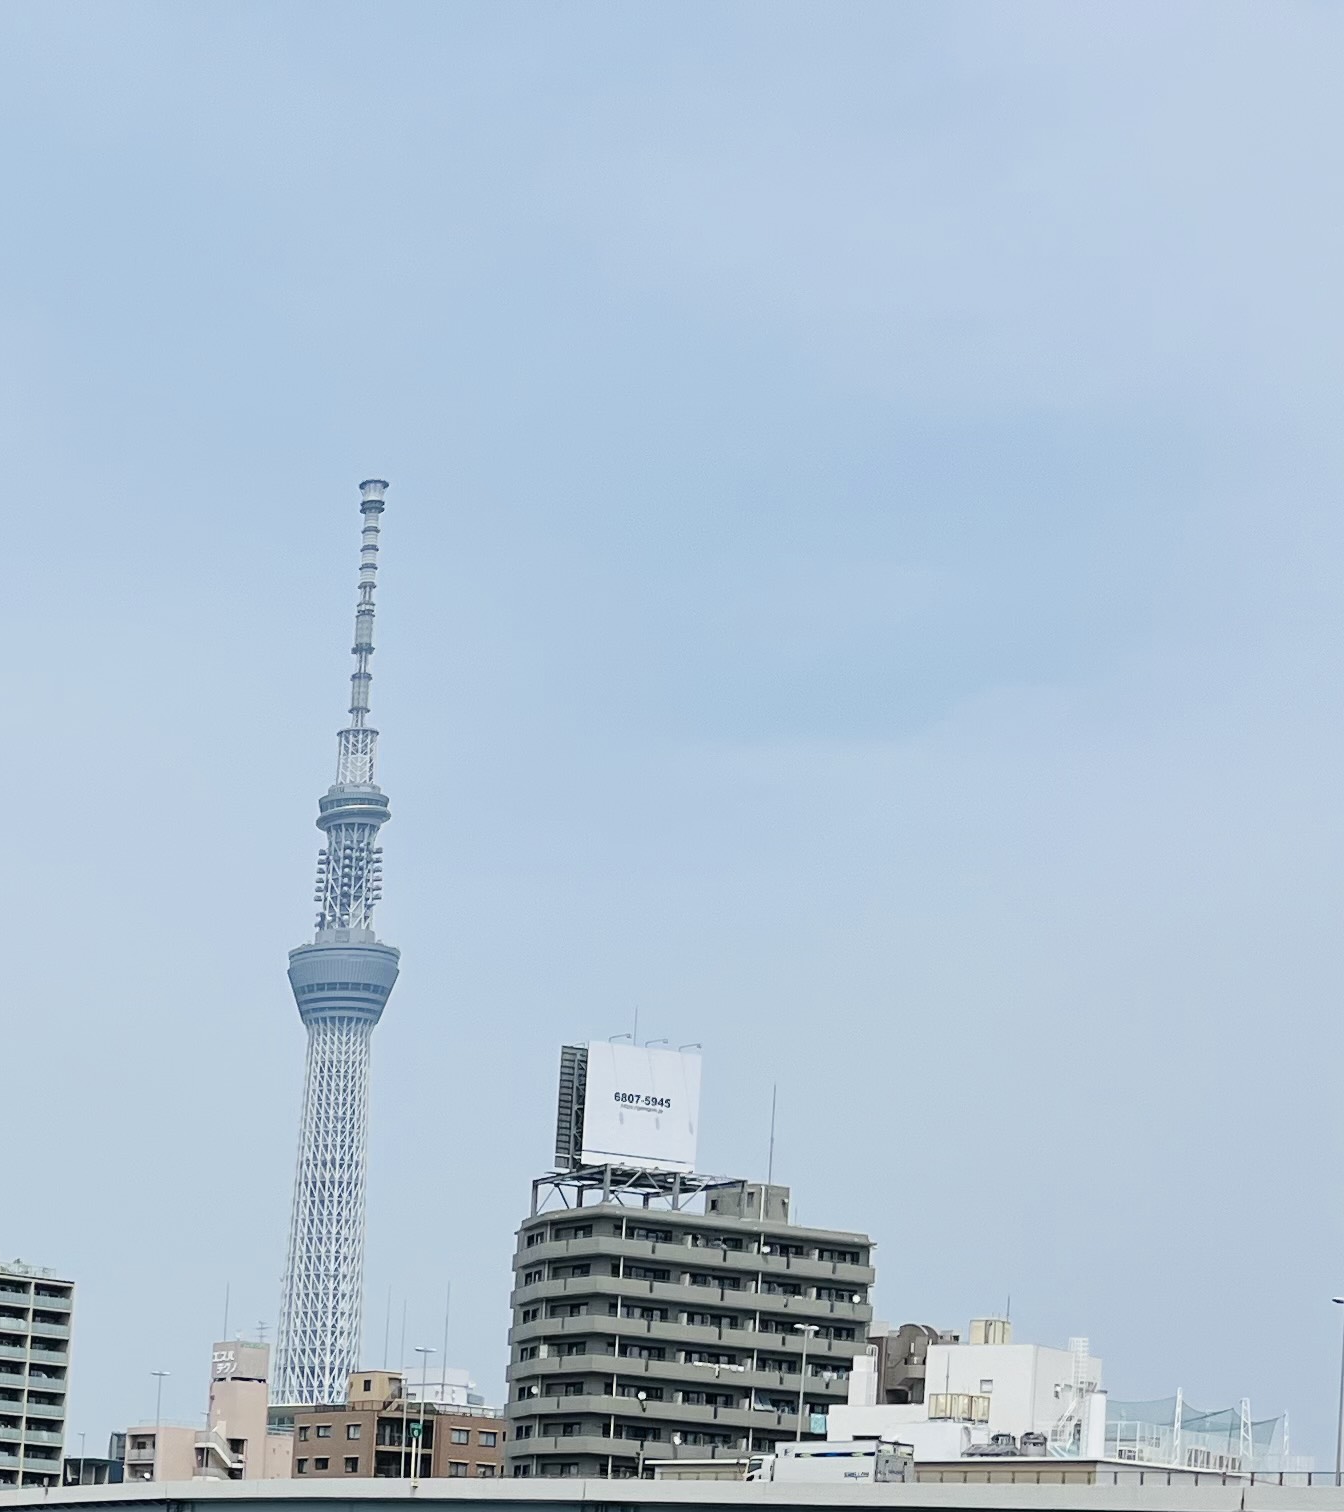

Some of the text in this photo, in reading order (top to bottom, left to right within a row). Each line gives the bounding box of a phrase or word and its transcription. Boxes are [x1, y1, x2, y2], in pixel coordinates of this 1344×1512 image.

[614, 1091, 671, 1109] 6807-5945
[216, 1362, 237, 1374] テクノ
